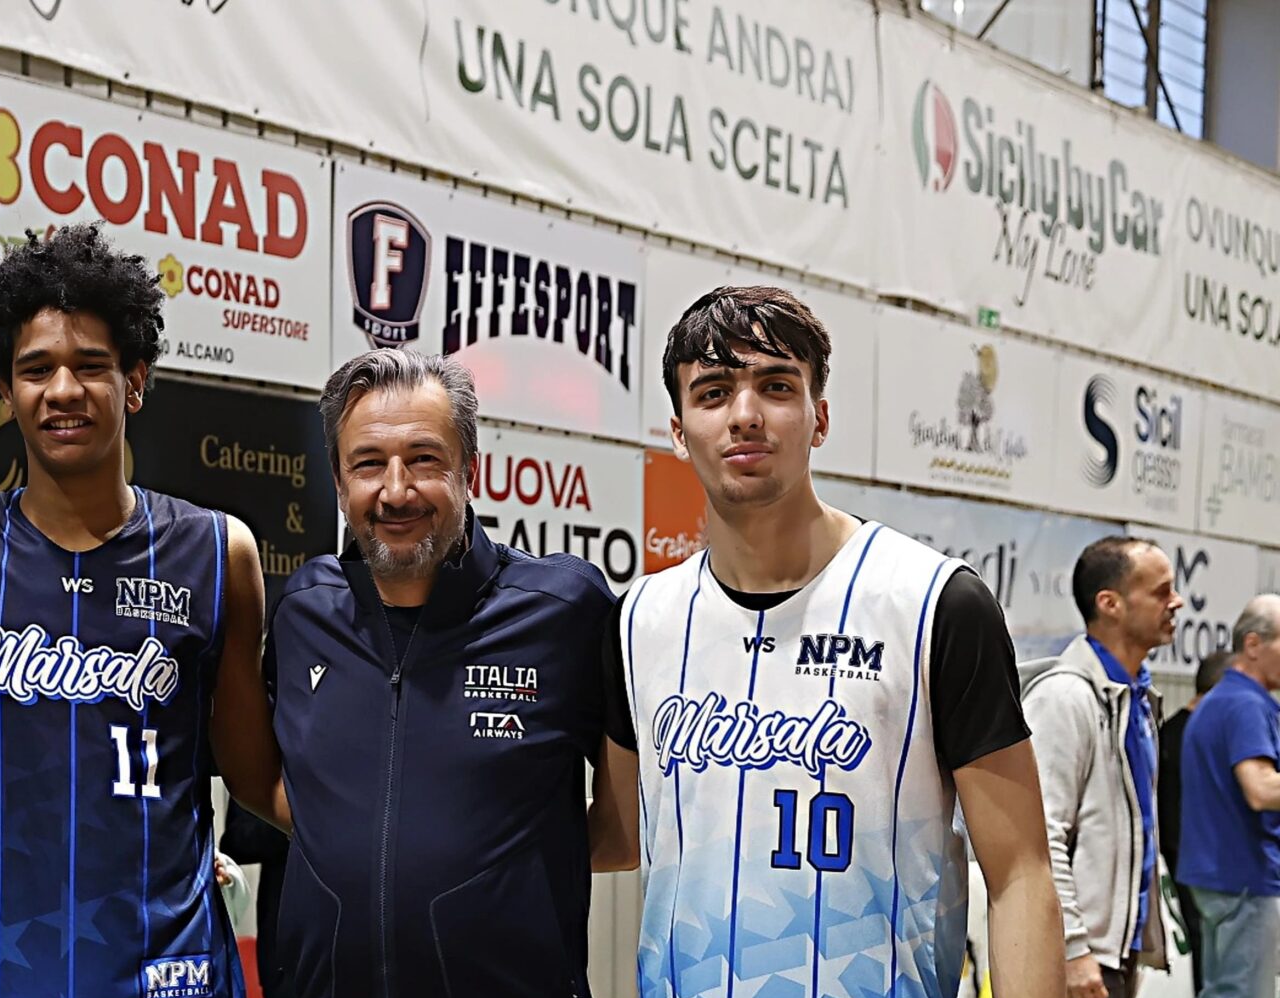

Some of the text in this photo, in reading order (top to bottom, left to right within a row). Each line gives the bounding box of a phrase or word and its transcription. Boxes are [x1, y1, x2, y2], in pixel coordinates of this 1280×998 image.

[706, 5, 854, 114] ANDRAI
[455, 18, 849, 208] UNA SOLA SCELTA
[29, 119, 308, 259] CONAD
[186, 264, 280, 309] CONAD
[222, 309, 309, 341] SUPERSTORE
[442, 234, 637, 392] EFFESPORT
[1184, 271, 1280, 346] UNA SOL
[176, 341, 235, 364] ALCAMO
[200, 434, 306, 488] Catering
[286, 502, 305, 534] &
[477, 515, 637, 583] AUTO
[62, 576, 94, 593] WS
[116, 577, 191, 618] NPM
[116, 607, 190, 627] BASKETBALL
[743, 636, 776, 653] WS
[797, 634, 884, 671] NPM
[464, 665, 538, 689] ITALIA
[795, 666, 881, 682] BASKETBALL
[464, 690, 538, 702] BASKETBALL
[473, 729, 524, 740] AIRWAYS
[652, 691, 872, 780] Marsala
[110, 725, 162, 798] 11
[770, 789, 855, 872] 10
[145, 960, 210, 990] NPM
[146, 987, 210, 998] BASKETBALL
